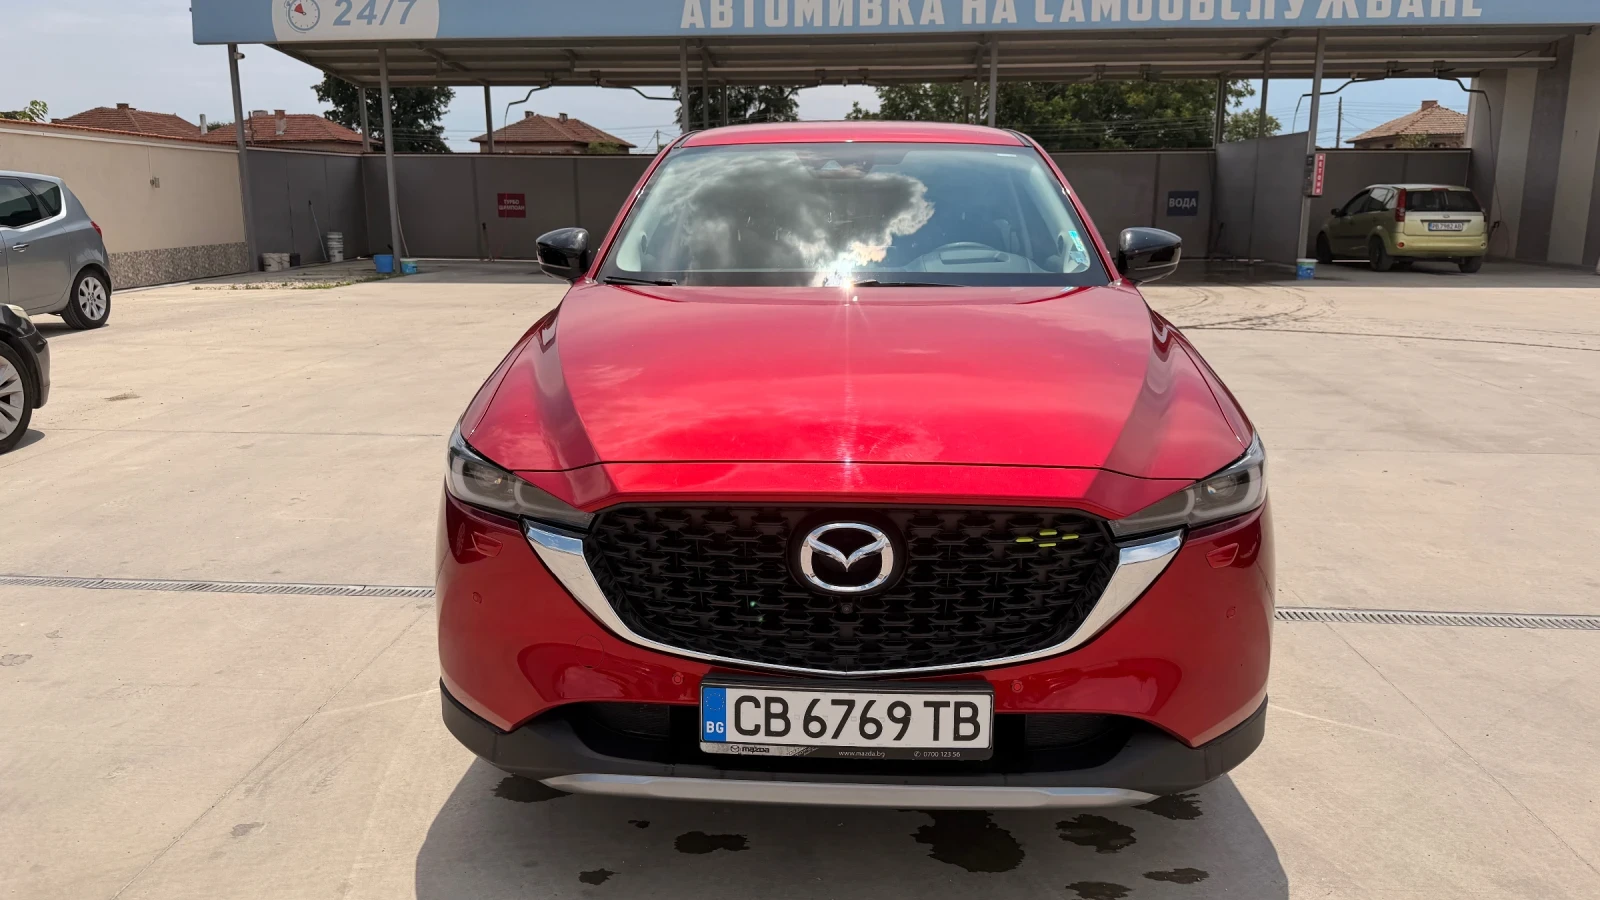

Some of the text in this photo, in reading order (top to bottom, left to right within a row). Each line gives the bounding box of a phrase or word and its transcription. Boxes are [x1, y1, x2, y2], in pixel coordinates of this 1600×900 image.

[333, 0, 416, 26] 24/7
[680, 0, 945, 29] АВТОМИВКА
[962, 0, 1018, 25] НА
[1169, 198, 1197, 209] ВОДА
[706, 721, 724, 733] BG
[734, 695, 981, 742] CB 6769 TB
[838, 750, 886, 758] www.mazda.bg
